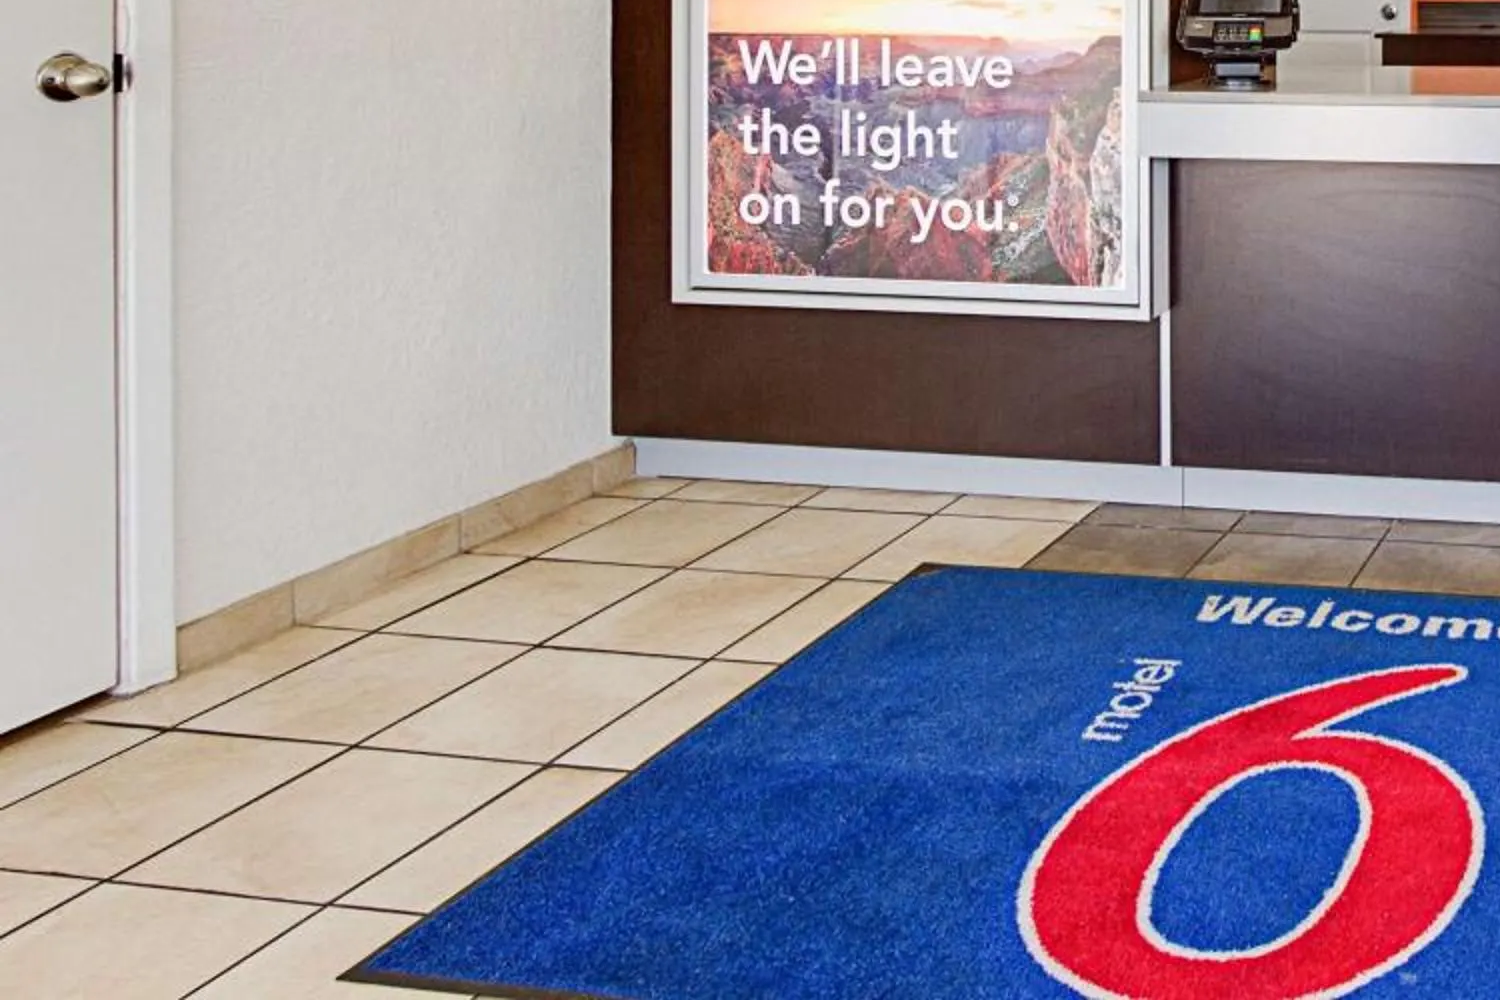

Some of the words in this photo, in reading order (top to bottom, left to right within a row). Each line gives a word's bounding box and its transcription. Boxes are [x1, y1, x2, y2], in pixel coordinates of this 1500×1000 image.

[739, 38, 859, 86] We'll
[881, 39, 1014, 88] leave
[738, 107, 821, 156] the
[841, 108, 961, 171] light
[739, 192, 801, 224] on
[819, 178, 895, 228] for
[1081, 658, 1182, 742] motel
[1016, 663, 1486, 1000] 6
